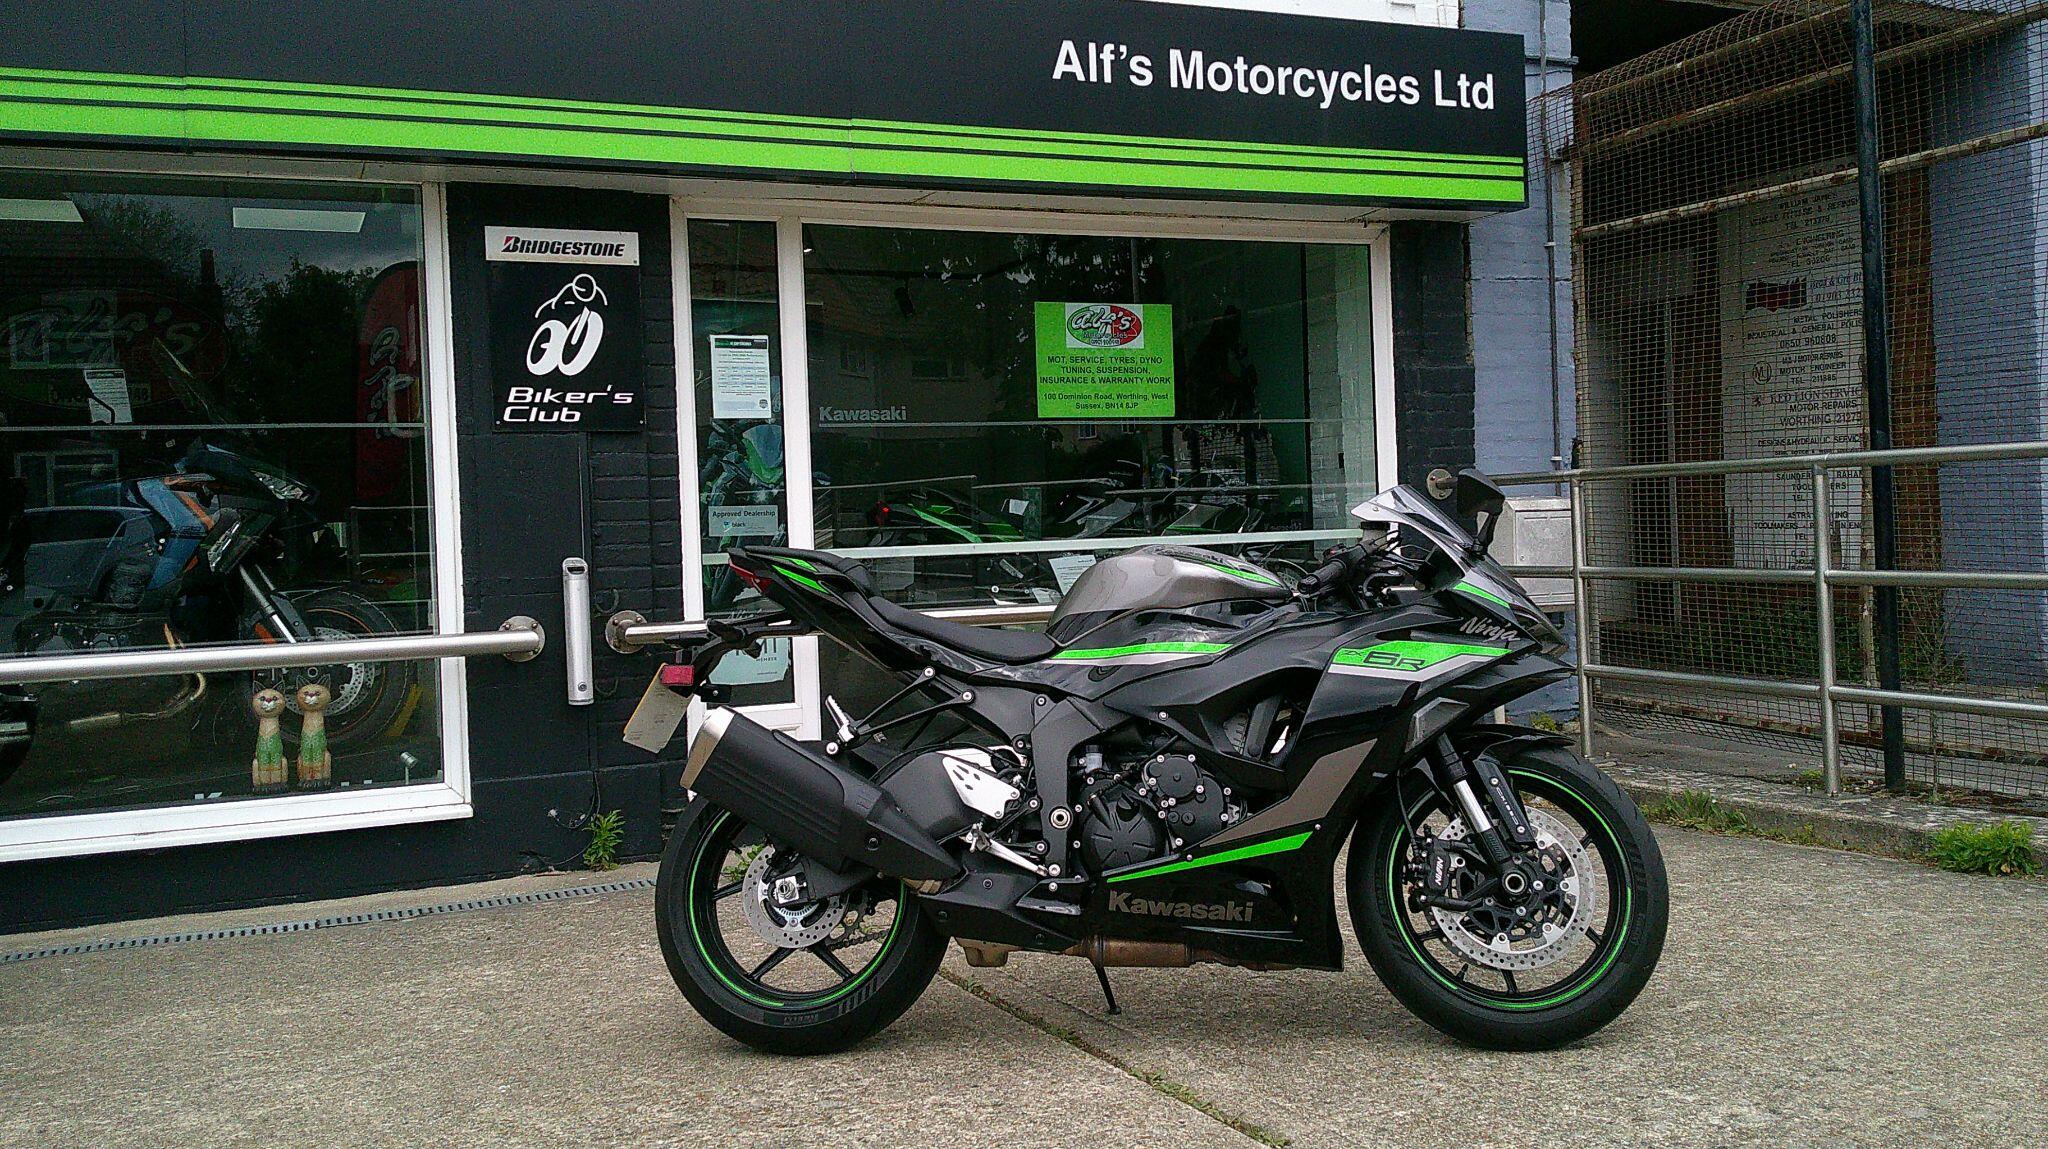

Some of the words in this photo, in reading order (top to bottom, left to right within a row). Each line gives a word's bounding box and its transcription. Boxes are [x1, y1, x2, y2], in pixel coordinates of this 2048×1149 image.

[1052, 39, 1154, 87] Alf's
[1169, 48, 1420, 110] Motorcycles
[1433, 69, 1495, 110] Ltd
[501, 235, 625, 257] BRIDGESTONE
[1801, 322, 1836, 334] GENERAL
[1109, 356, 1137, 365] TYRES,
[1140, 356, 1163, 364] DYNO
[1061, 366, 1094, 375] TUNING,
[1096, 366, 1151, 375] SUSPENSION,
[1780, 367, 1805, 375] MOTOR
[1811, 362, 1846, 372] ENGINEER
[1040, 376, 1088, 384] INSURANCE
[1090, 376, 1096, 384] &
[1099, 376, 1144, 384] WARRANTY
[1146, 376, 1171, 384] WORK
[507, 384, 634, 404] Biker's
[1094, 393, 1114, 402] Road,
[1115, 393, 1150, 402] Worthing,
[1075, 402, 1103, 411] Sussex,
[1105, 402, 1124, 410] BN14
[1789, 402, 1820, 413] MOTOR
[1822, 399, 1858, 410] REPAIRS
[503, 406, 581, 422] Club
[819, 405, 907, 421] Kawasaki
[1780, 413, 1832, 427] WORTHING
[1792, 494, 1805, 502] TEL
[712, 511, 742, 519] Approved
[743, 510, 776, 518] Dealership
[1460, 616, 1521, 643] Ninja
[1108, 889, 1254, 922] Kawasaki
